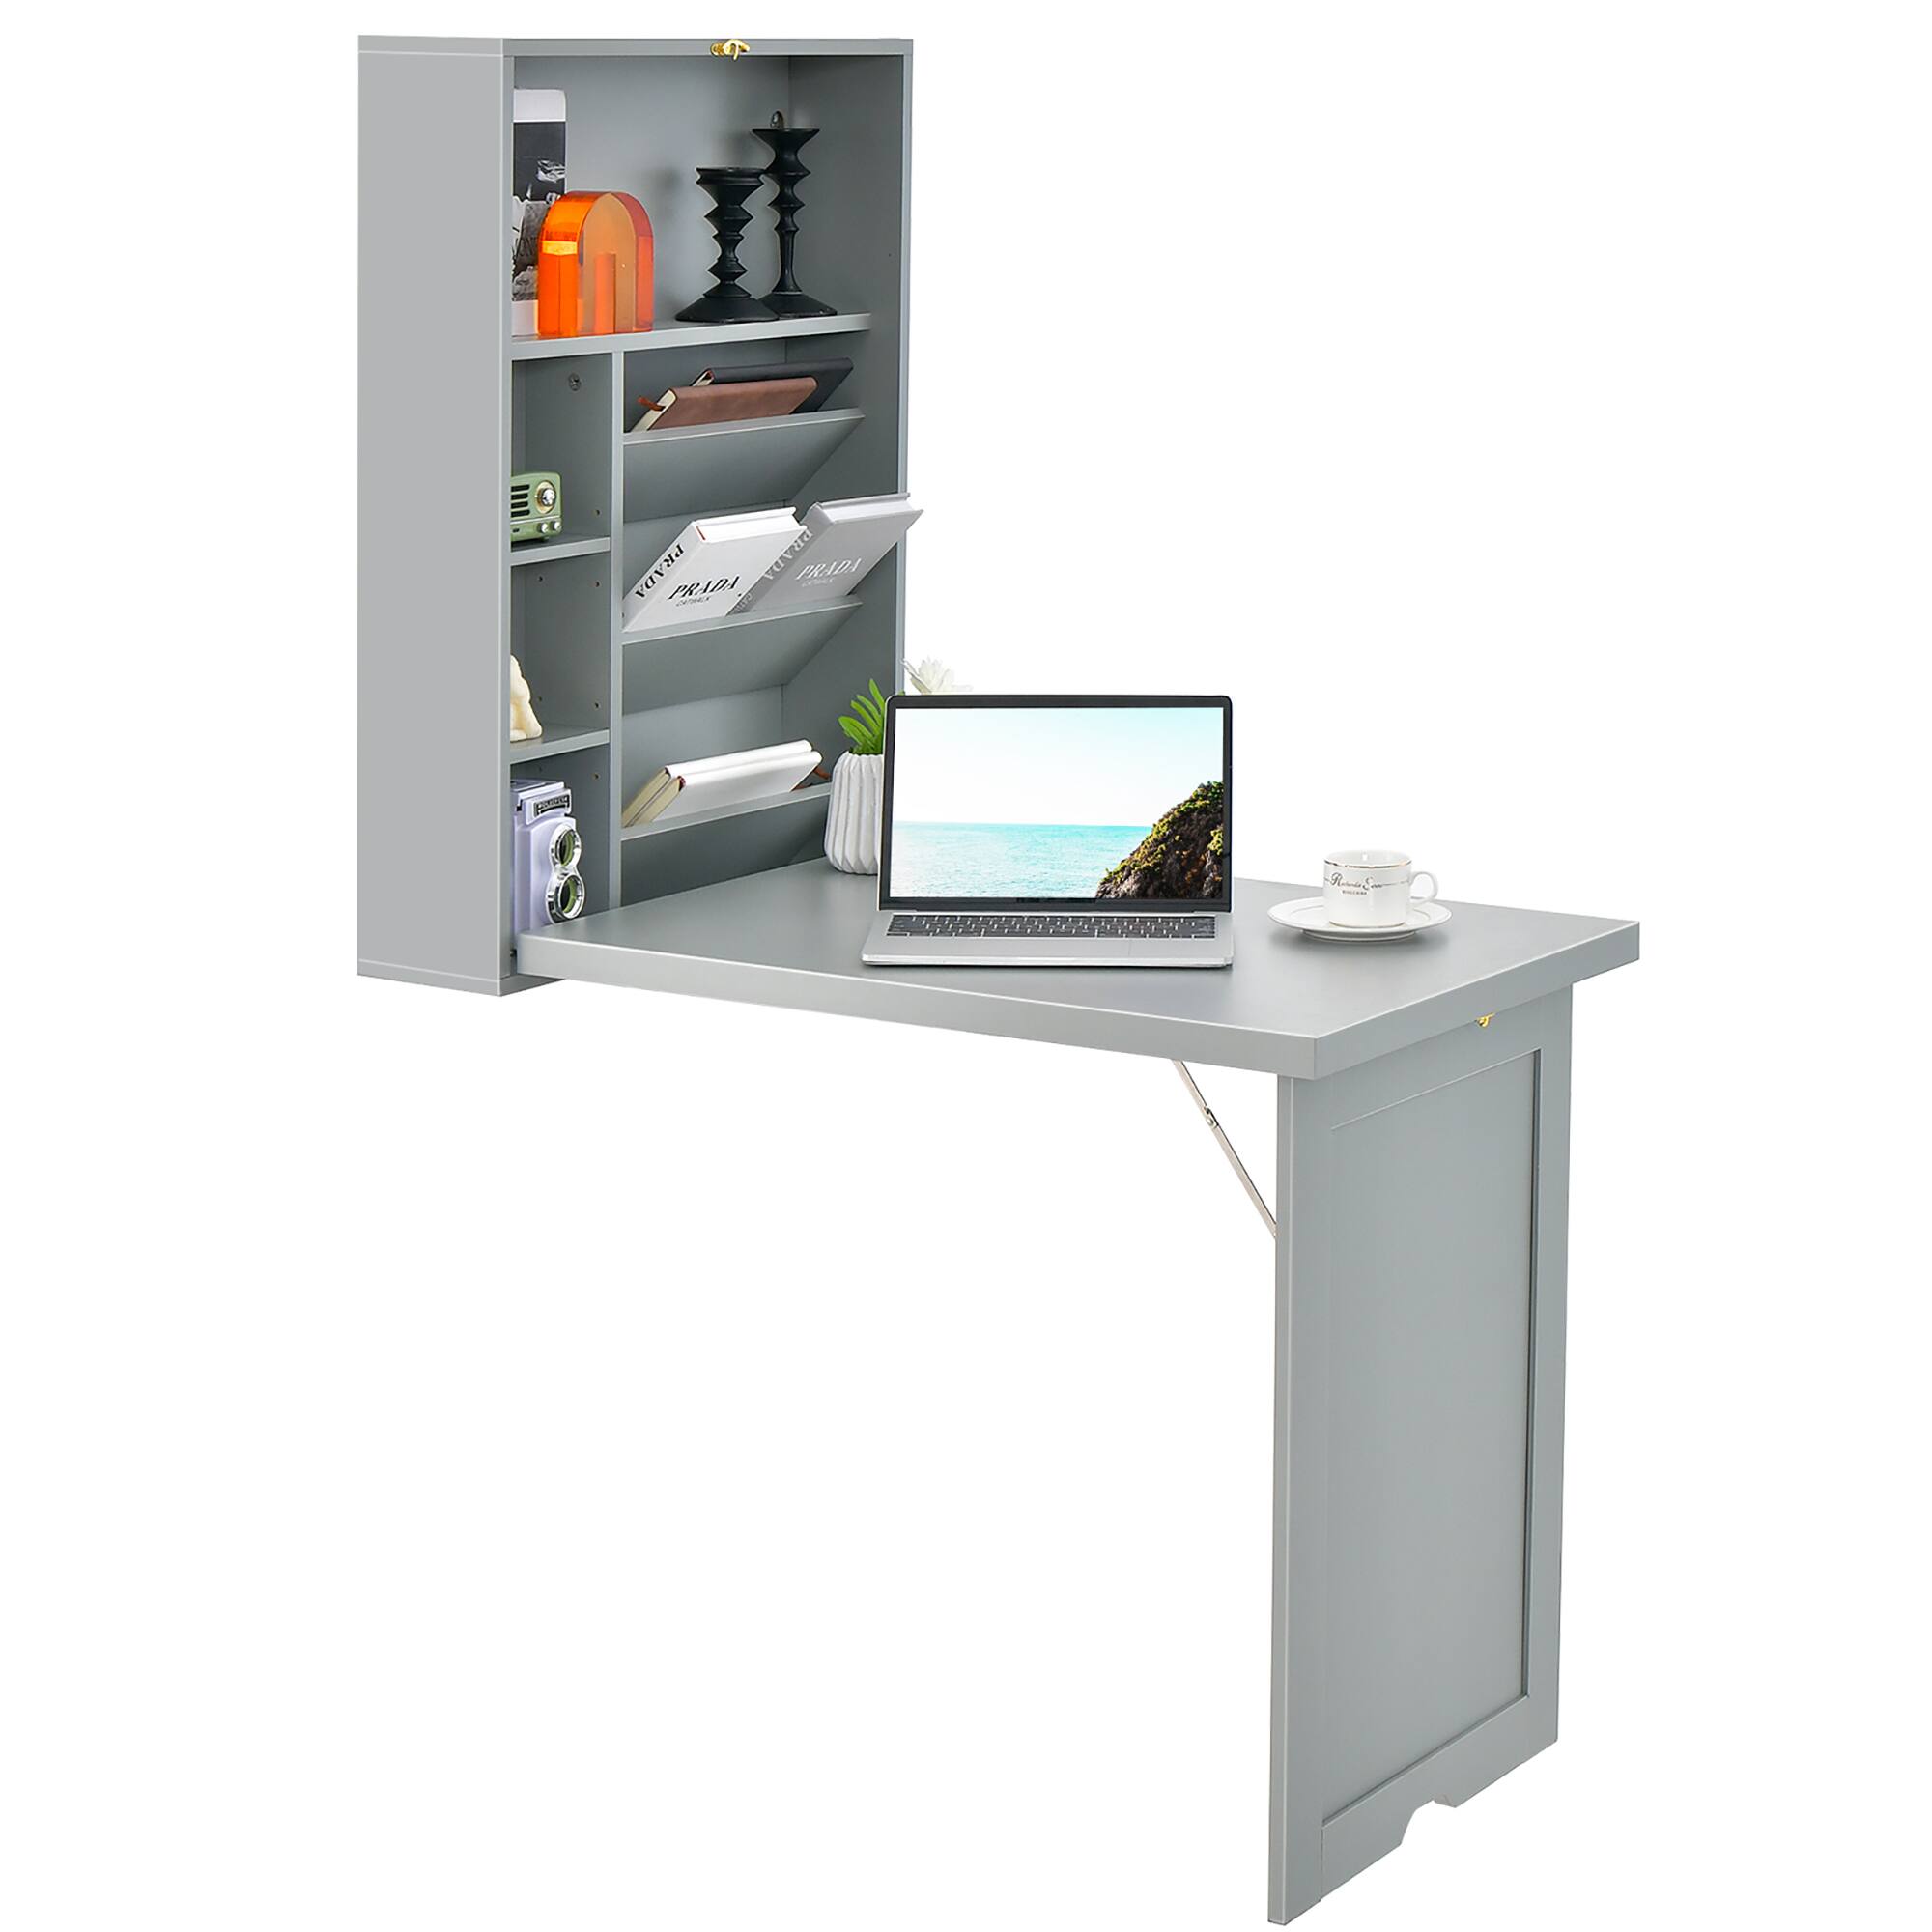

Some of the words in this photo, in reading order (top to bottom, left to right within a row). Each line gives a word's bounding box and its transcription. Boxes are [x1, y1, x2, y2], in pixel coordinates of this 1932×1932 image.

[635, 544, 684, 598] PRADA
[763, 528, 813, 581] PRADA
[795, 557, 862, 581] PRADA
[668, 576, 740, 600] PRADA
